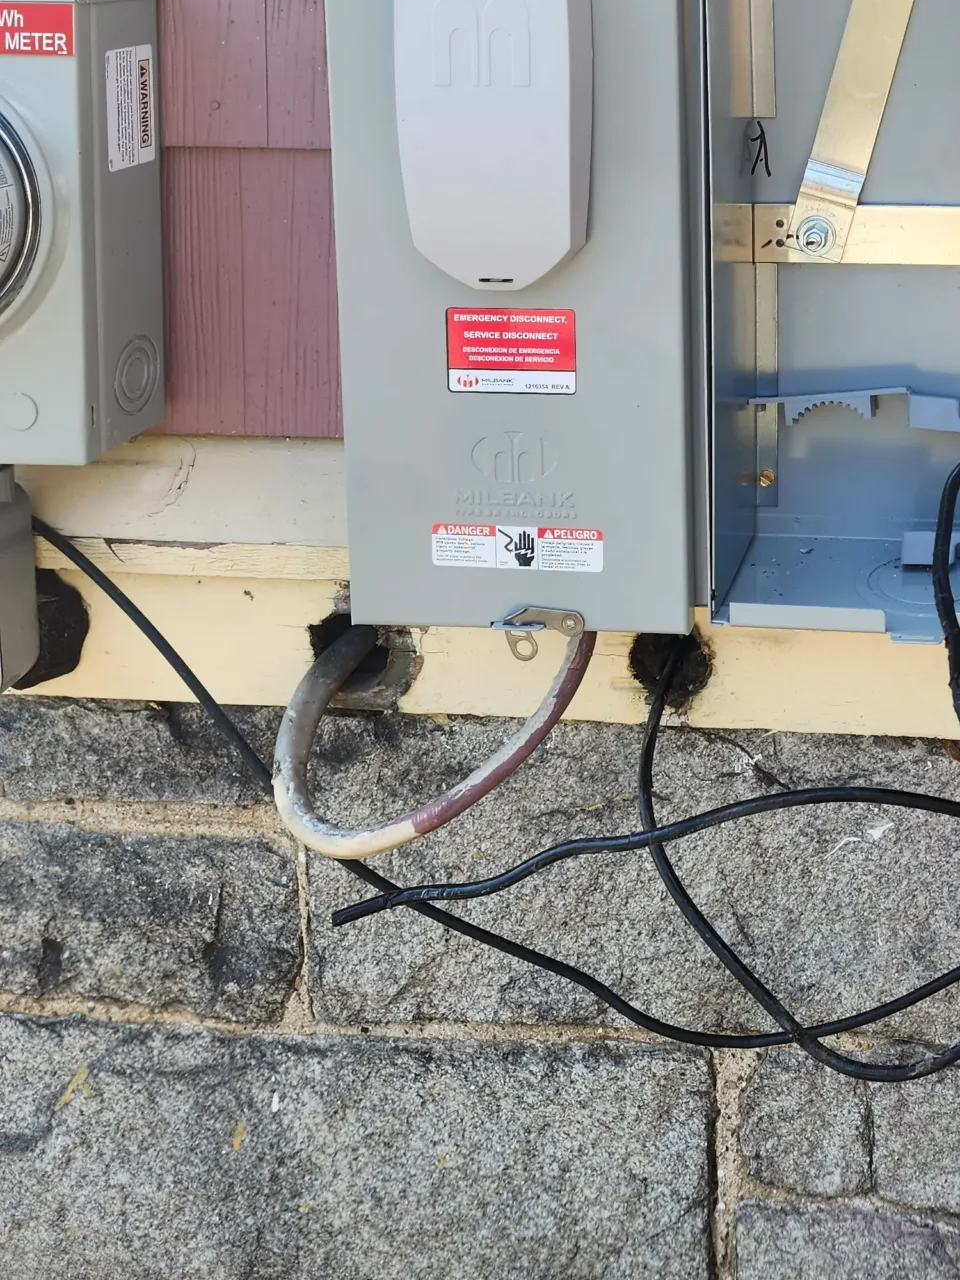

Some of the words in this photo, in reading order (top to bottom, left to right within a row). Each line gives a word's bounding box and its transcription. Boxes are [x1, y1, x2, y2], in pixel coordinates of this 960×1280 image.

[5, 32, 68, 51] METER
[140, 79, 149, 144] WARNING
[454, 314, 508, 323] EMERGENCY
[463, 331, 500, 339] SERVICE
[502, 332, 558, 340] DISCONNECT
[462, 346, 508, 354] DESCONEXION
[468, 355, 514, 363] DESCONEXION
[455, 489, 576, 508] MILBANK
[447, 525, 491, 536] DANGER
[553, 529, 598, 540] PELIGRO
